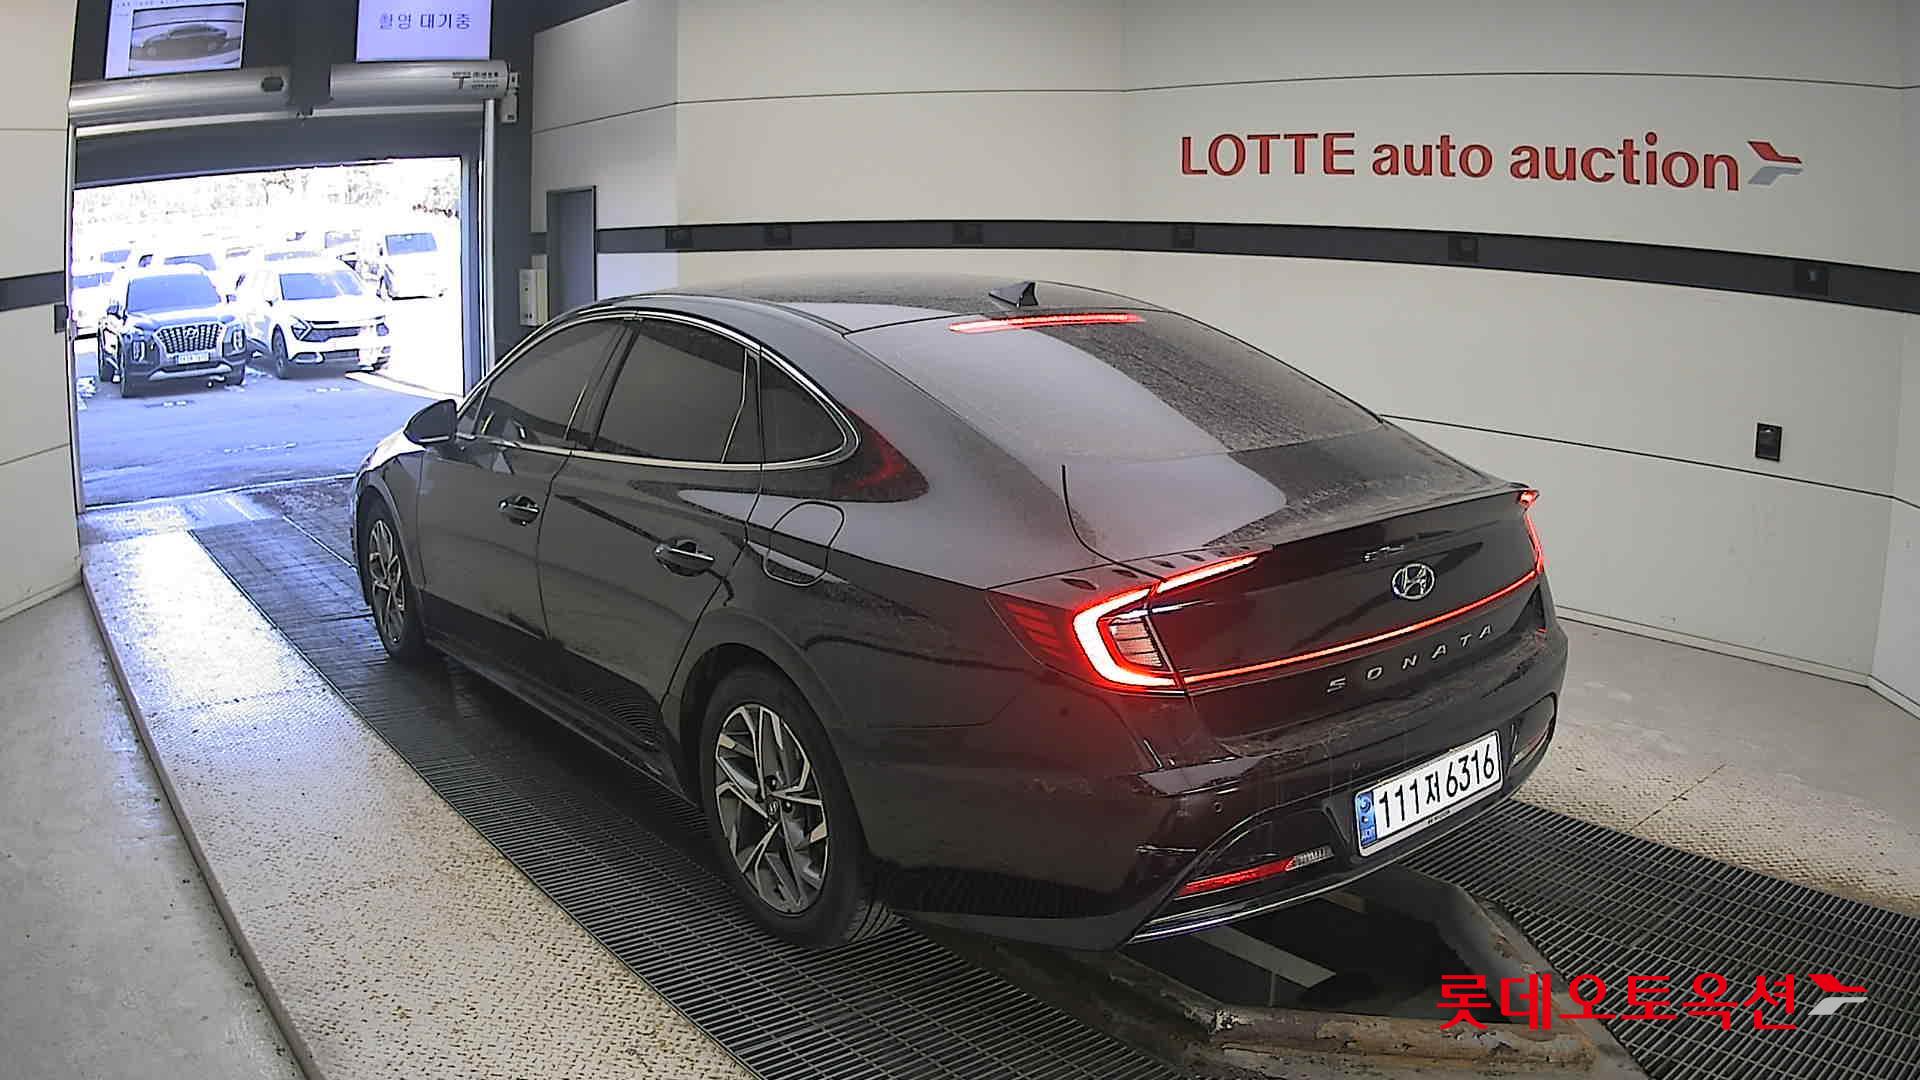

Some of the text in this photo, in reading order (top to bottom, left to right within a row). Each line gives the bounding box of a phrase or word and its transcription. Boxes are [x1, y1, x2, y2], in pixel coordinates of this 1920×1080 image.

[420, 12, 472, 31] 대기중
[1182, 132, 1741, 191] LOTTE auto auction
[1326, 623, 1494, 694] SONATA
